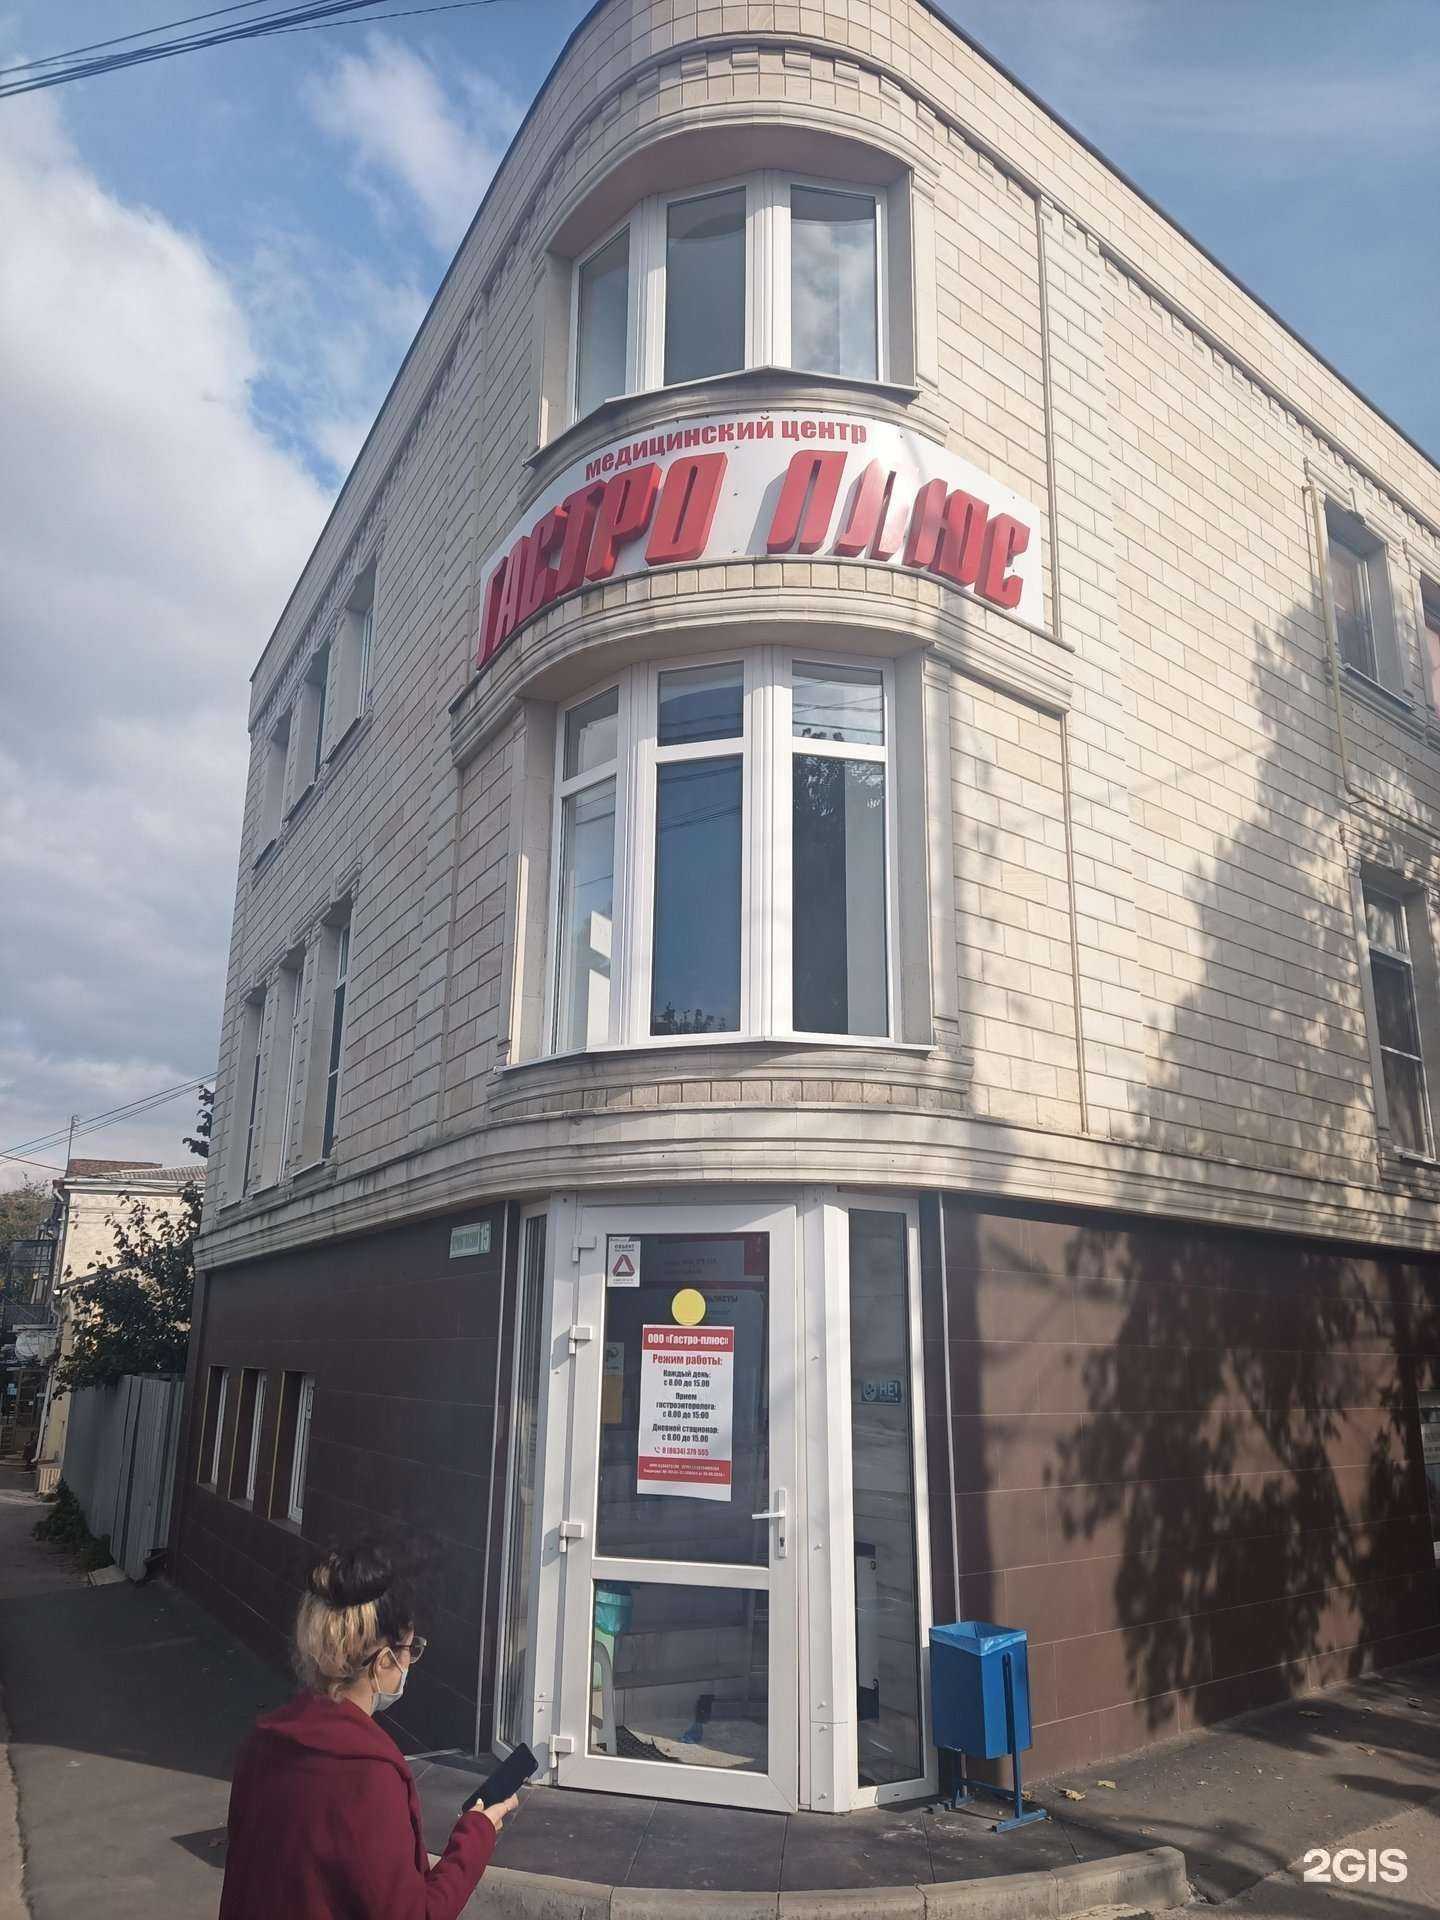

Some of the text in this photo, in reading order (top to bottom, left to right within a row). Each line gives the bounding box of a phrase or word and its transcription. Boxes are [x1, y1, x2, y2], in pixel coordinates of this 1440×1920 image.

[584, 414, 867, 482] медицинский центр
[477, 449, 1031, 670] ГАСТРО ПЛЮС
[648, 1333, 665, 1344] ООО
[652, 1354, 723, 1366] Режим работы:
[683, 1380, 692, 1388] до
